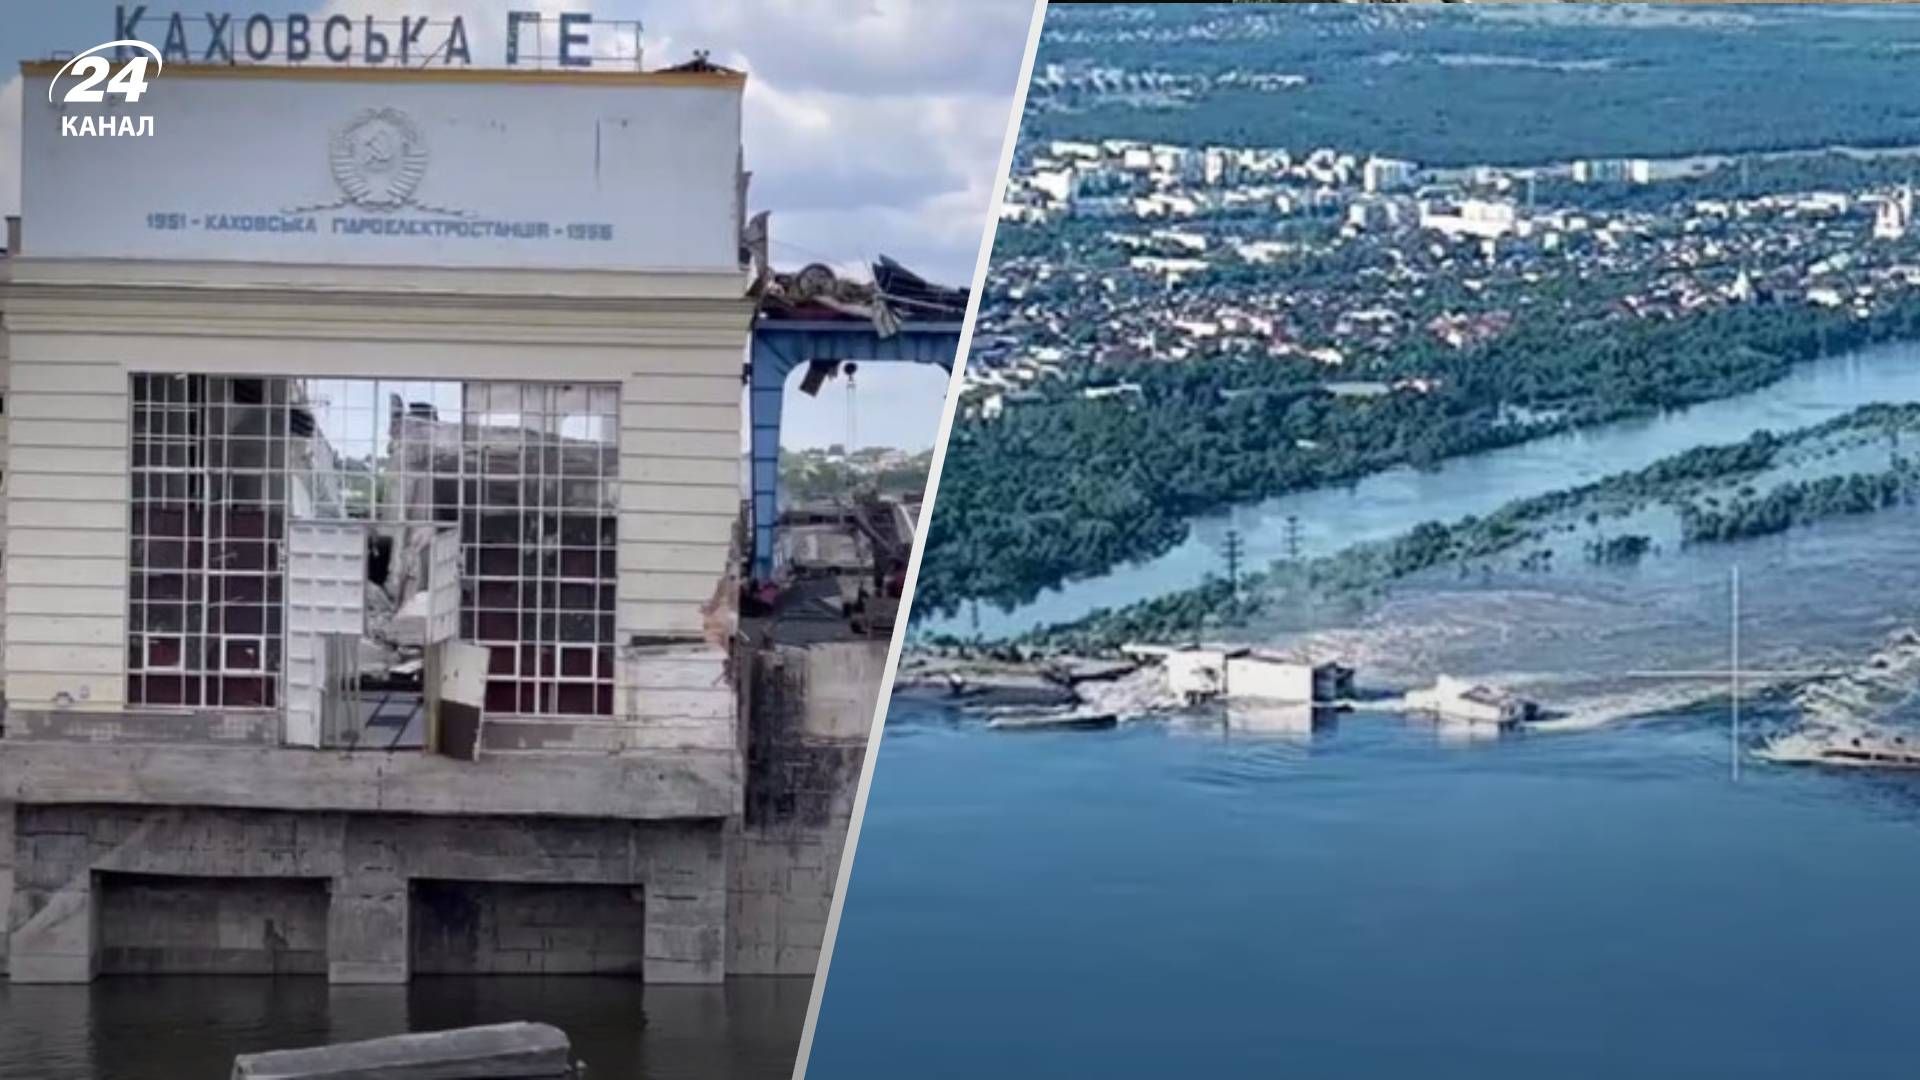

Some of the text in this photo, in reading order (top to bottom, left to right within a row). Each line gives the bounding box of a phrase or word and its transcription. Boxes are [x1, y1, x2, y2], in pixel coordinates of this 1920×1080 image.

[114, 4, 472, 65] КАХОВСЬКА
[146, 212, 186, 230] 1951
[204, 214, 317, 234] КАХОВСЬКА
